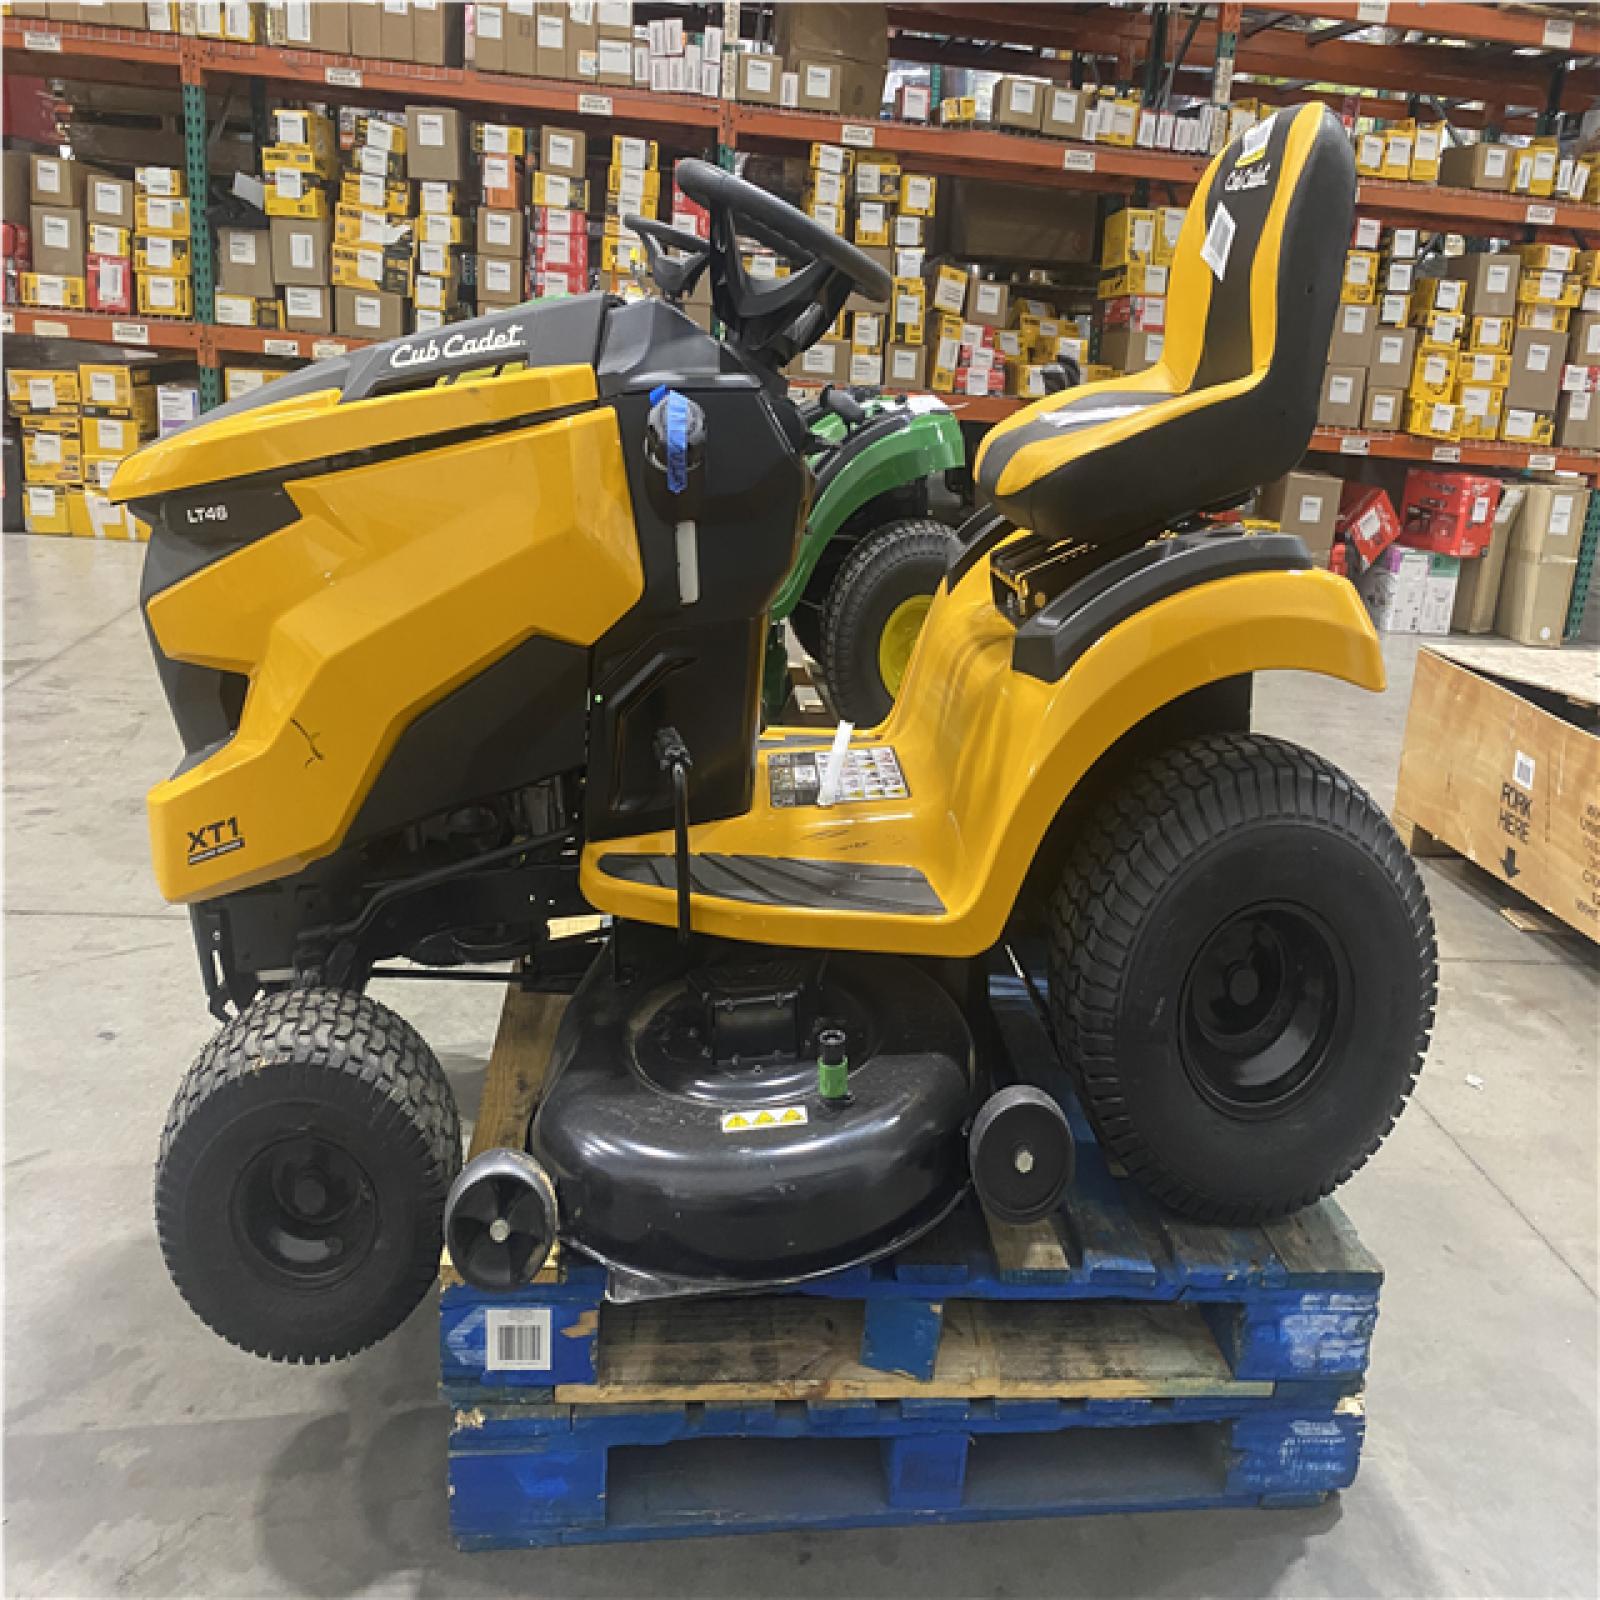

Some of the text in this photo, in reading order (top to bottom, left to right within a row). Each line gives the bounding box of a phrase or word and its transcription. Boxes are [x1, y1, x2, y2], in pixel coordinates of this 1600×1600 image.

[390, 324, 524, 368] Cub Cadet
[1500, 782, 1532, 819] FORK
[187, 816, 238, 853] XT1
[1498, 807, 1530, 845] HERE
